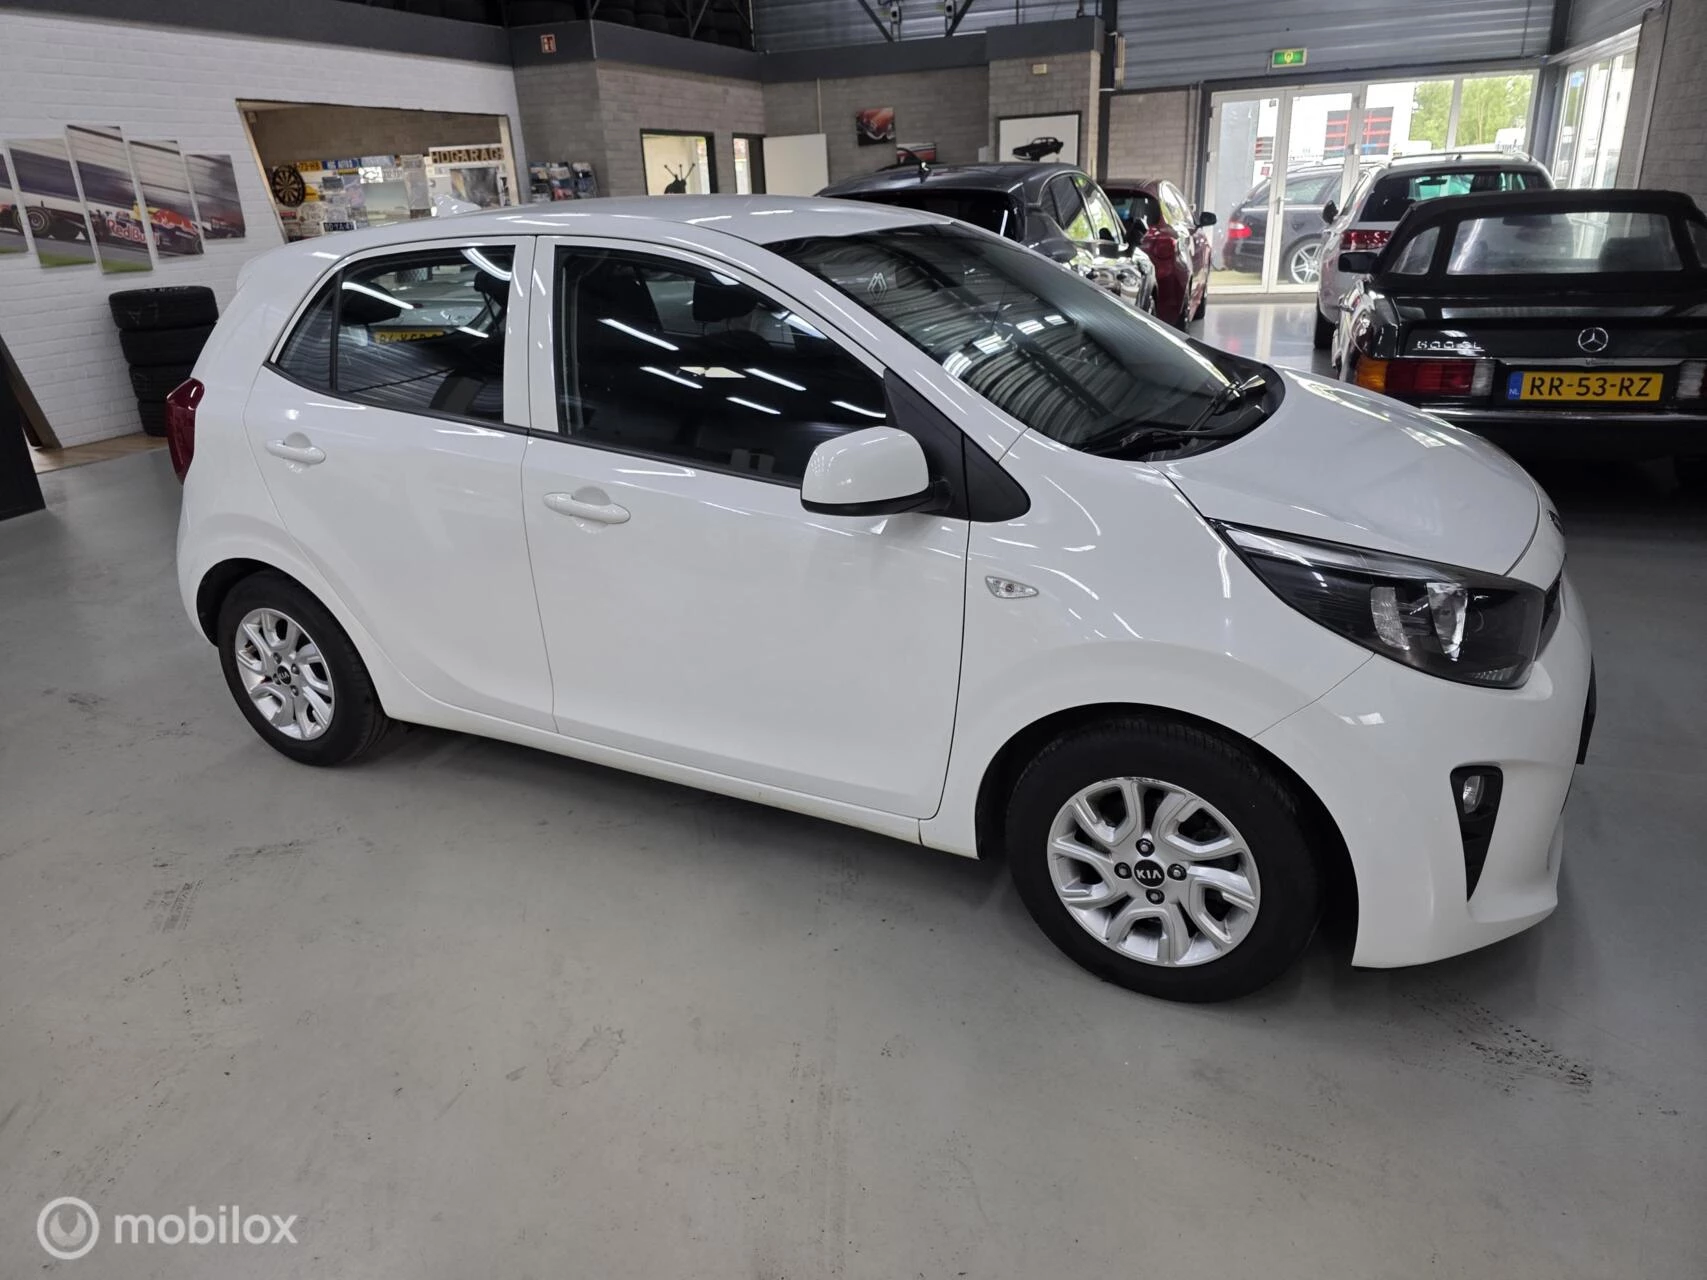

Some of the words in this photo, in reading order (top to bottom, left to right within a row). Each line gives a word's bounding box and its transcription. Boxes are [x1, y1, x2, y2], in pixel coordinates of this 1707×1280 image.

[1529, 376, 1653, 397] RR-53-RZ
[1508, 388, 1520, 396] NL
[1135, 869, 1162, 879] KIA
